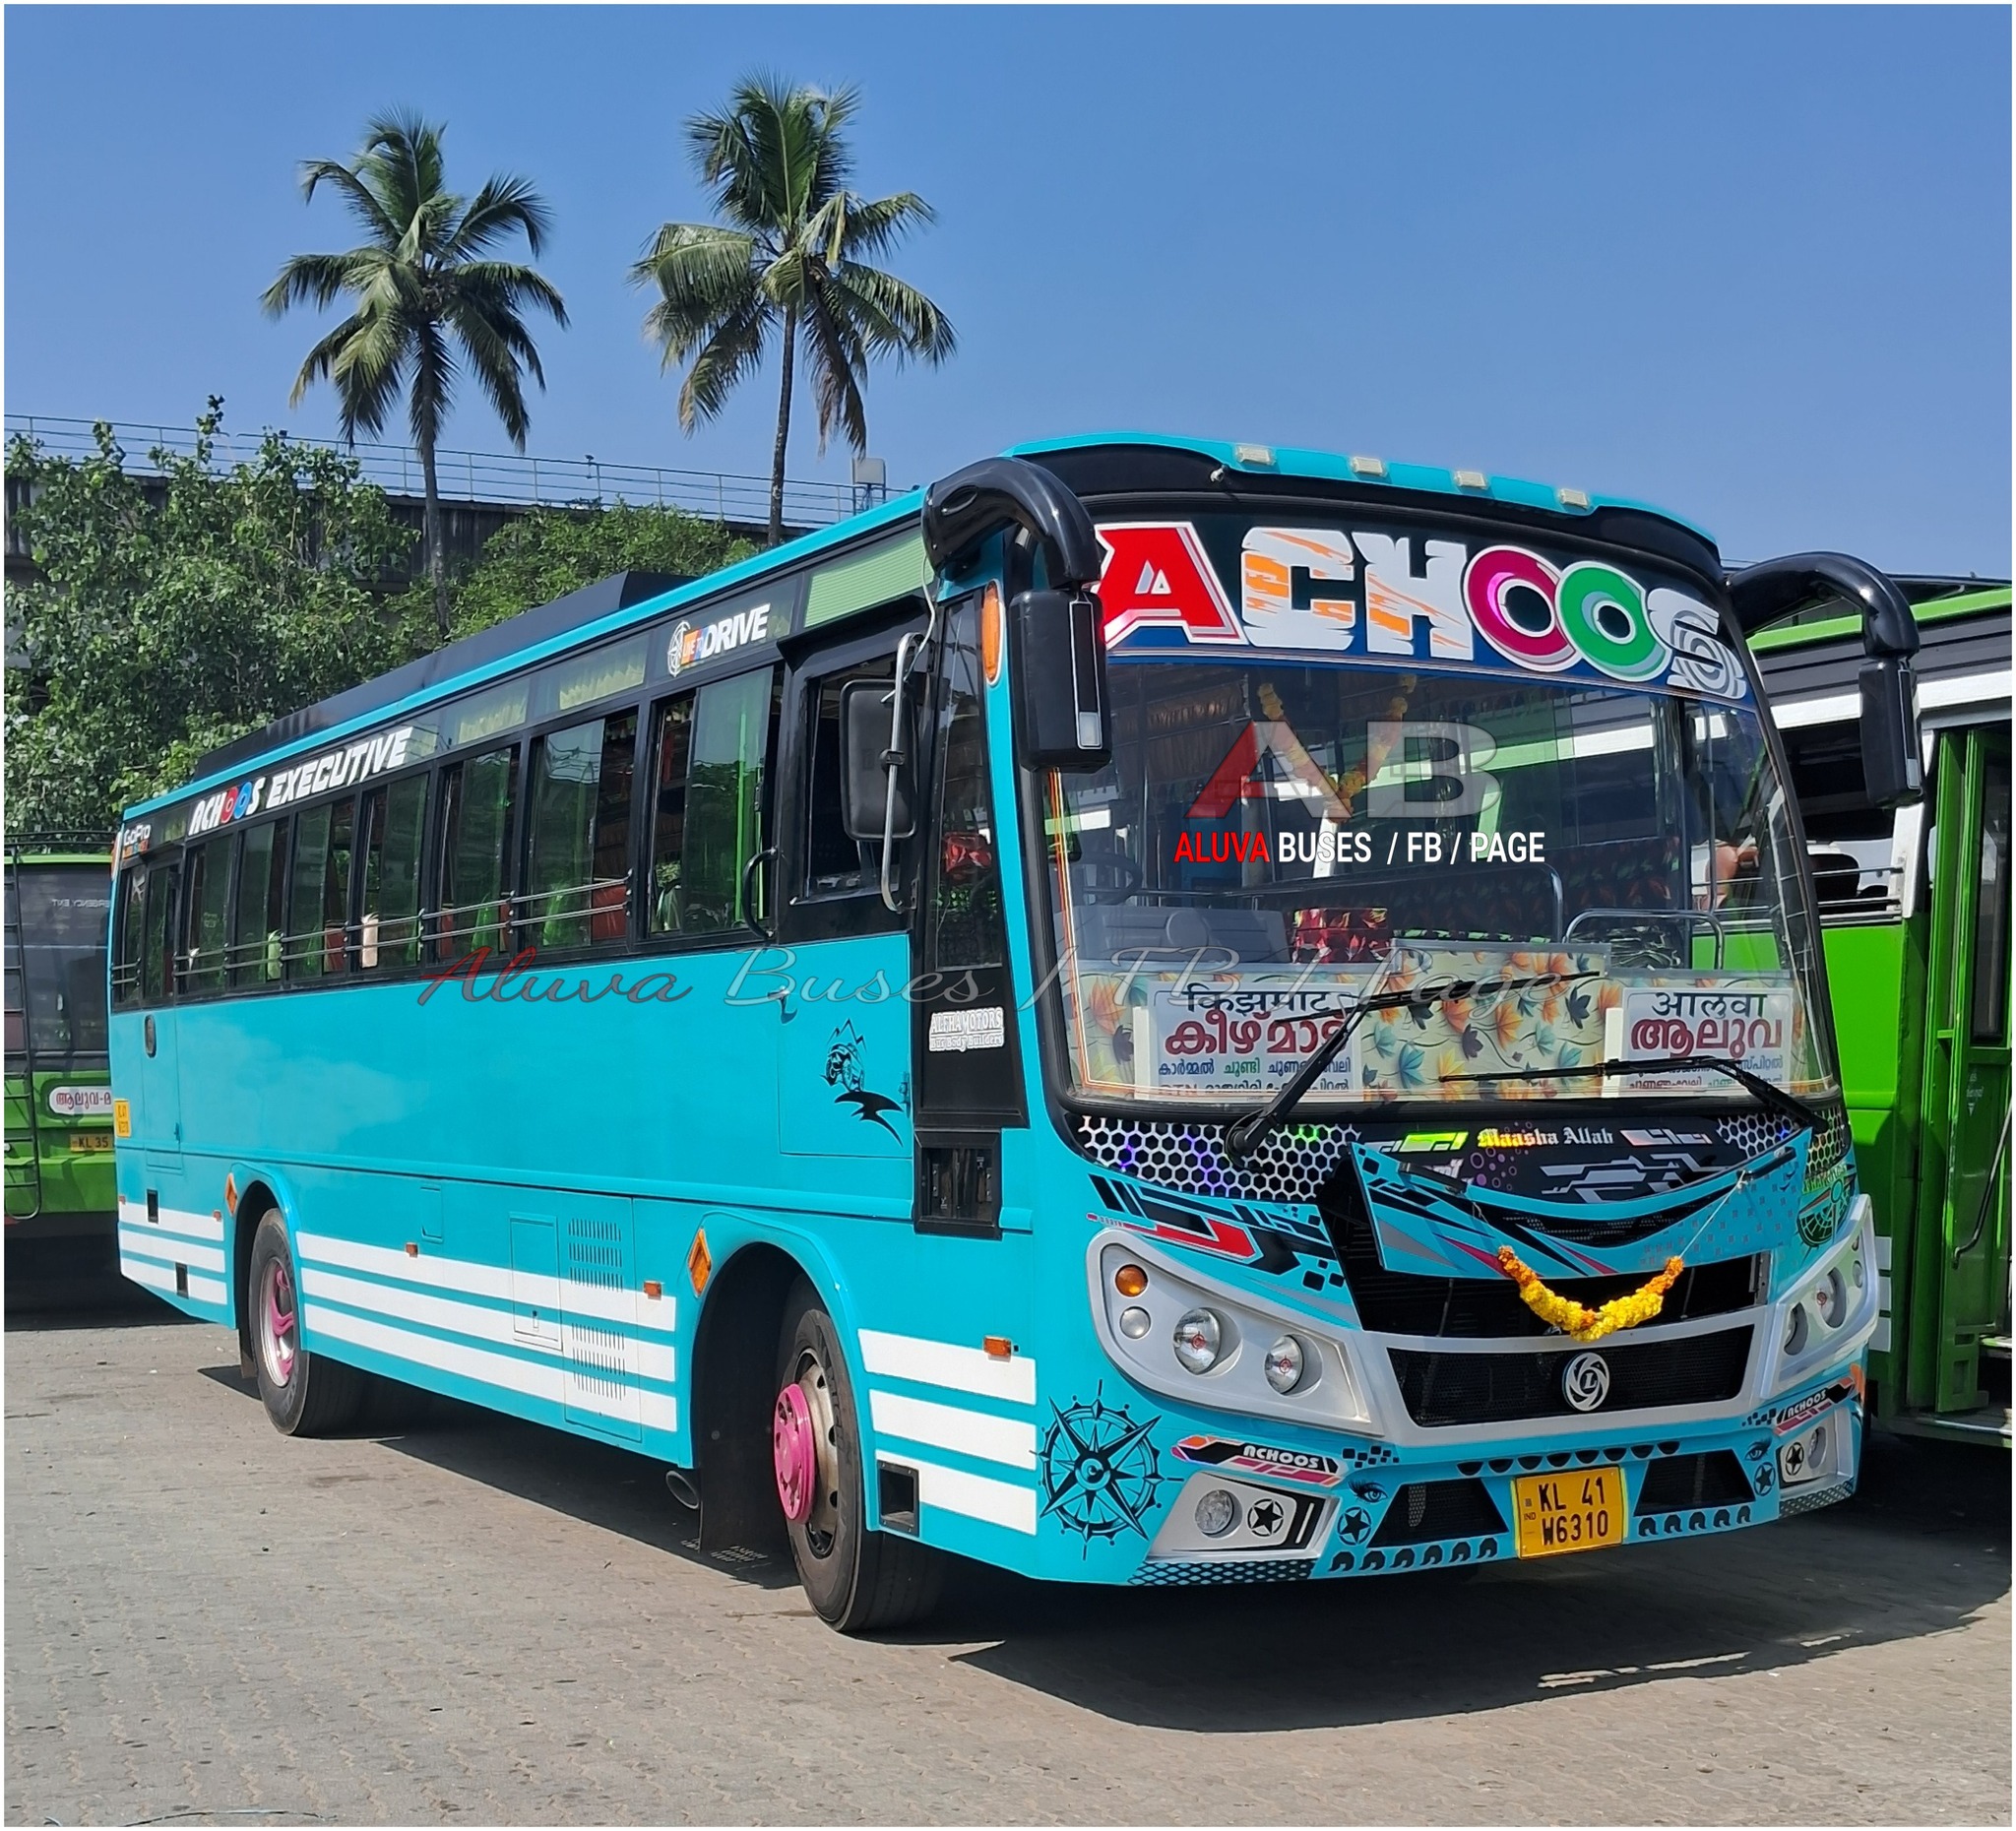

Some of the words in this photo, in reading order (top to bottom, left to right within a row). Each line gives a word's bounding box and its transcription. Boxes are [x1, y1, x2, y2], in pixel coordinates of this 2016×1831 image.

[1092, 522, 1747, 700] ACHOOS
[700, 602, 771, 659] DRIVE
[188, 777, 266, 837] ACHOOS
[266, 726, 413, 809] EXECUTIVE
[1631, 1018, 1783, 1059] ആലുവ
[78, 1136, 93, 1149] KL
[94, 1136, 109, 1149] 35
[1477, 1127, 1560, 1148] Maasha
[1562, 1126, 1614, 1145] Allah
[1788, 1388, 1828, 1419] ACHOOS
[1242, 1444, 1320, 1470] ACHOOS
[1538, 1482, 1567, 1512] KL
[1581, 1476, 1606, 1506] 41
[1542, 1509, 1609, 1547] W6310
